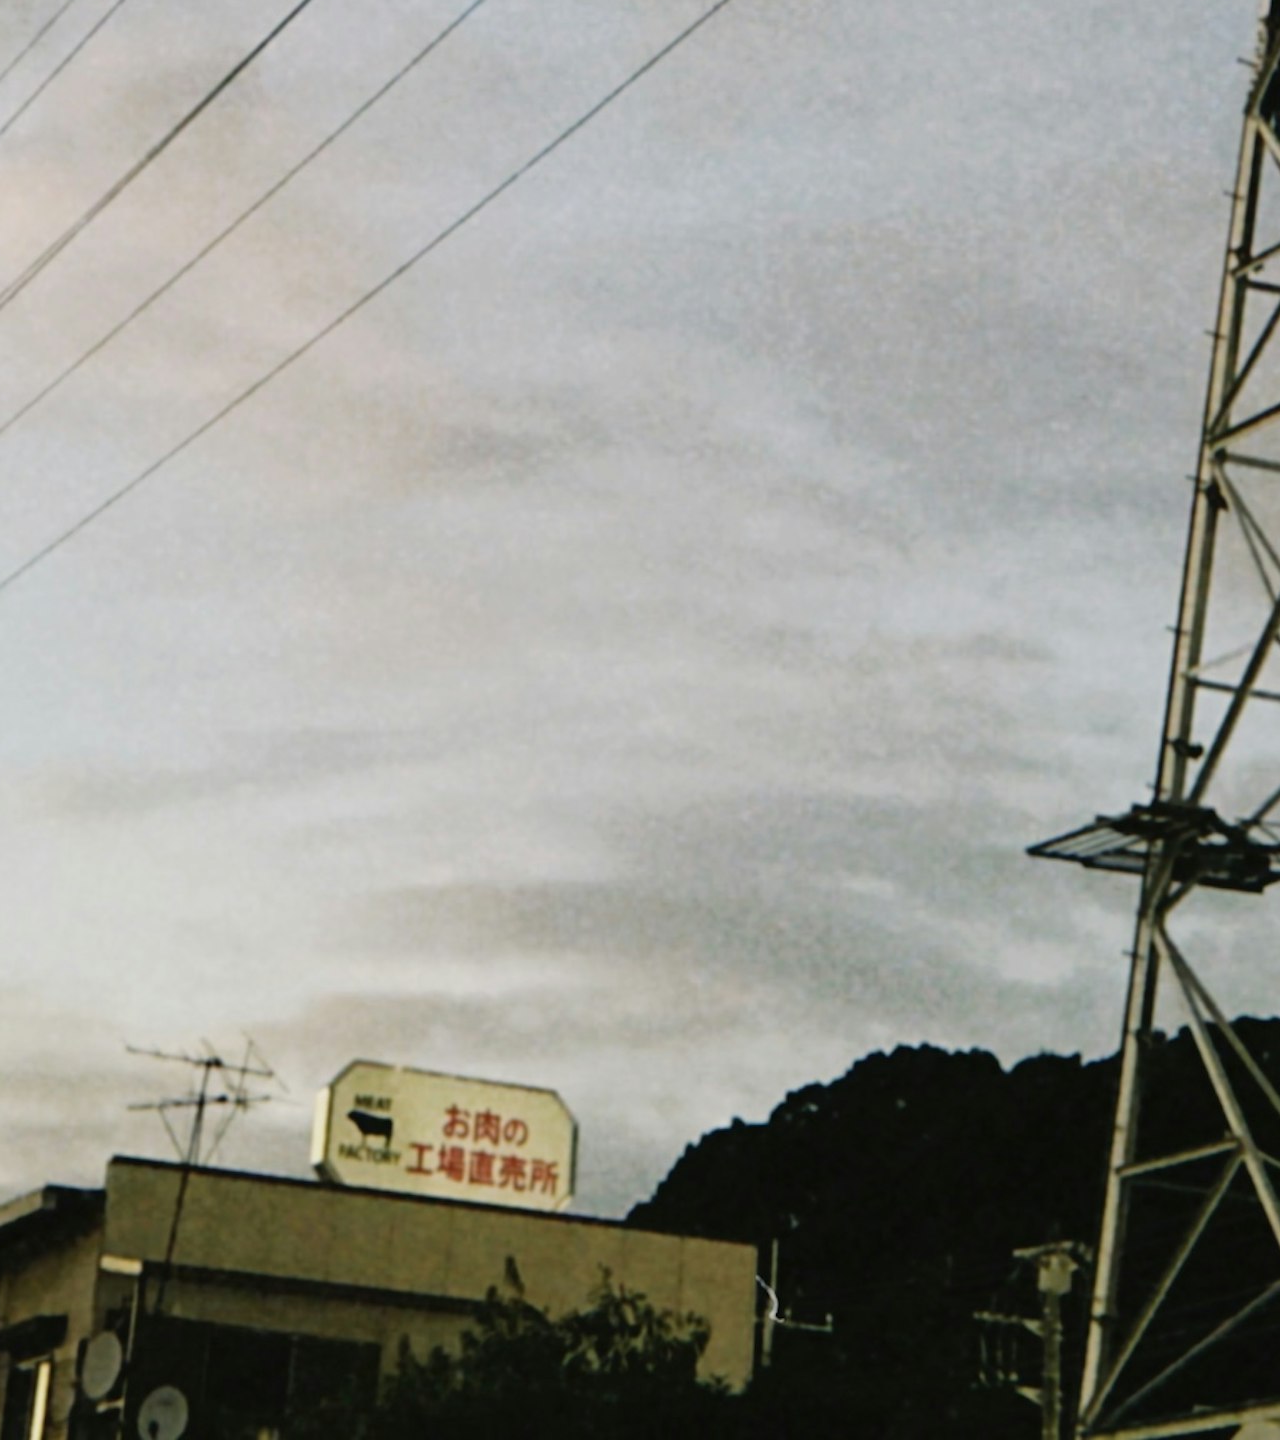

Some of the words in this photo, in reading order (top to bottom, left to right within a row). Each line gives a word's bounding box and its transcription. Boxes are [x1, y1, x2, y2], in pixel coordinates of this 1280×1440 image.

[354, 1094, 392, 1112] MEAT
[442, 1103, 529, 1146] お肉の
[337, 1143, 402, 1165] FACTORY
[405, 1142, 560, 1196] 工場直売所
